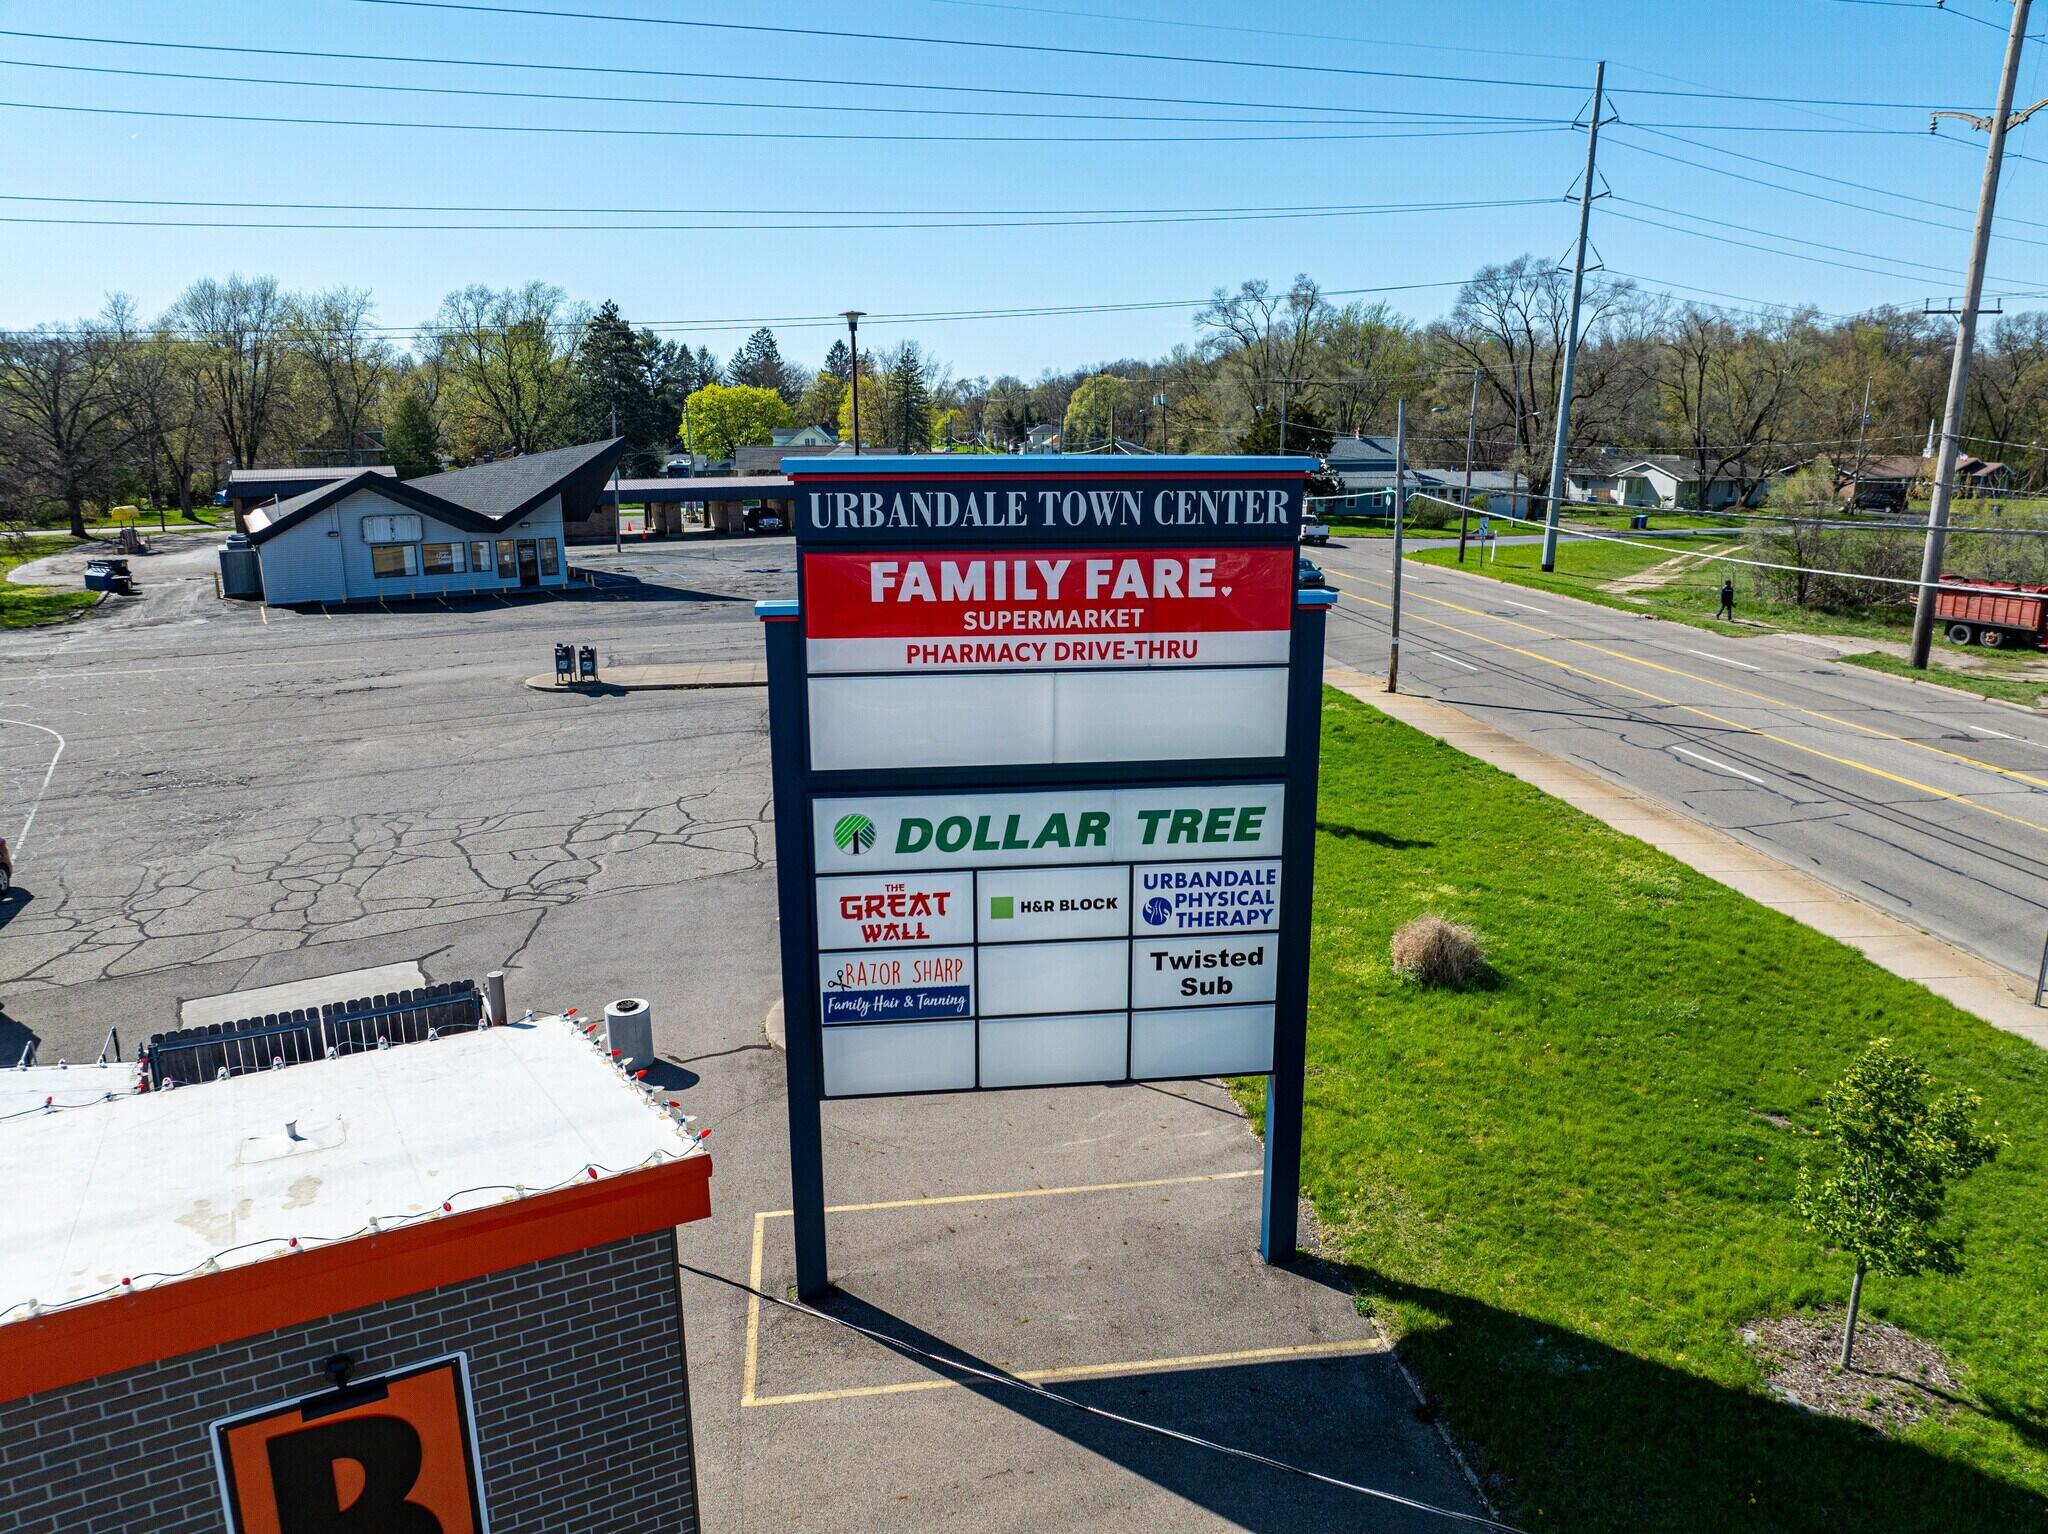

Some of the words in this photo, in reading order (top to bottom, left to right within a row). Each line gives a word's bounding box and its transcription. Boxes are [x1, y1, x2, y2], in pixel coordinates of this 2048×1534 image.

[809, 491, 1028, 529] URBANDALE
[1038, 490, 1143, 527] TOWN
[1154, 489, 1289, 527] CENTER
[870, 559, 1068, 603] FAMILY
[963, 608, 1144, 631] SUPERMARKET
[906, 641, 1049, 664] PHARMACY
[1053, 639, 1199, 661] DRIVE-THRU
[895, 811, 1111, 854] DOLLAR
[1136, 806, 1266, 845] TREE
[885, 884, 905, 892] THE
[1143, 869, 1276, 890] URBANDALE
[840, 892, 951, 921] GREAT
[1021, 900, 1054, 913] H&R
[1060, 897, 1118, 911] BLOCK
[1175, 889, 1275, 908] PHYSICAL
[1176, 908, 1274, 928] THERAPY
[861, 922, 930, 943] WALL
[1150, 947, 1264, 971] Twisted
[845, 960, 900, 986] RAZOR
[912, 958, 963, 983] SHARP
[1180, 976, 1233, 996] Sub
[828, 996, 871, 1016] Family
[870, 994, 900, 1012] Hair
[903, 995, 914, 1008] &
[917, 993, 967, 1012] Tanning
